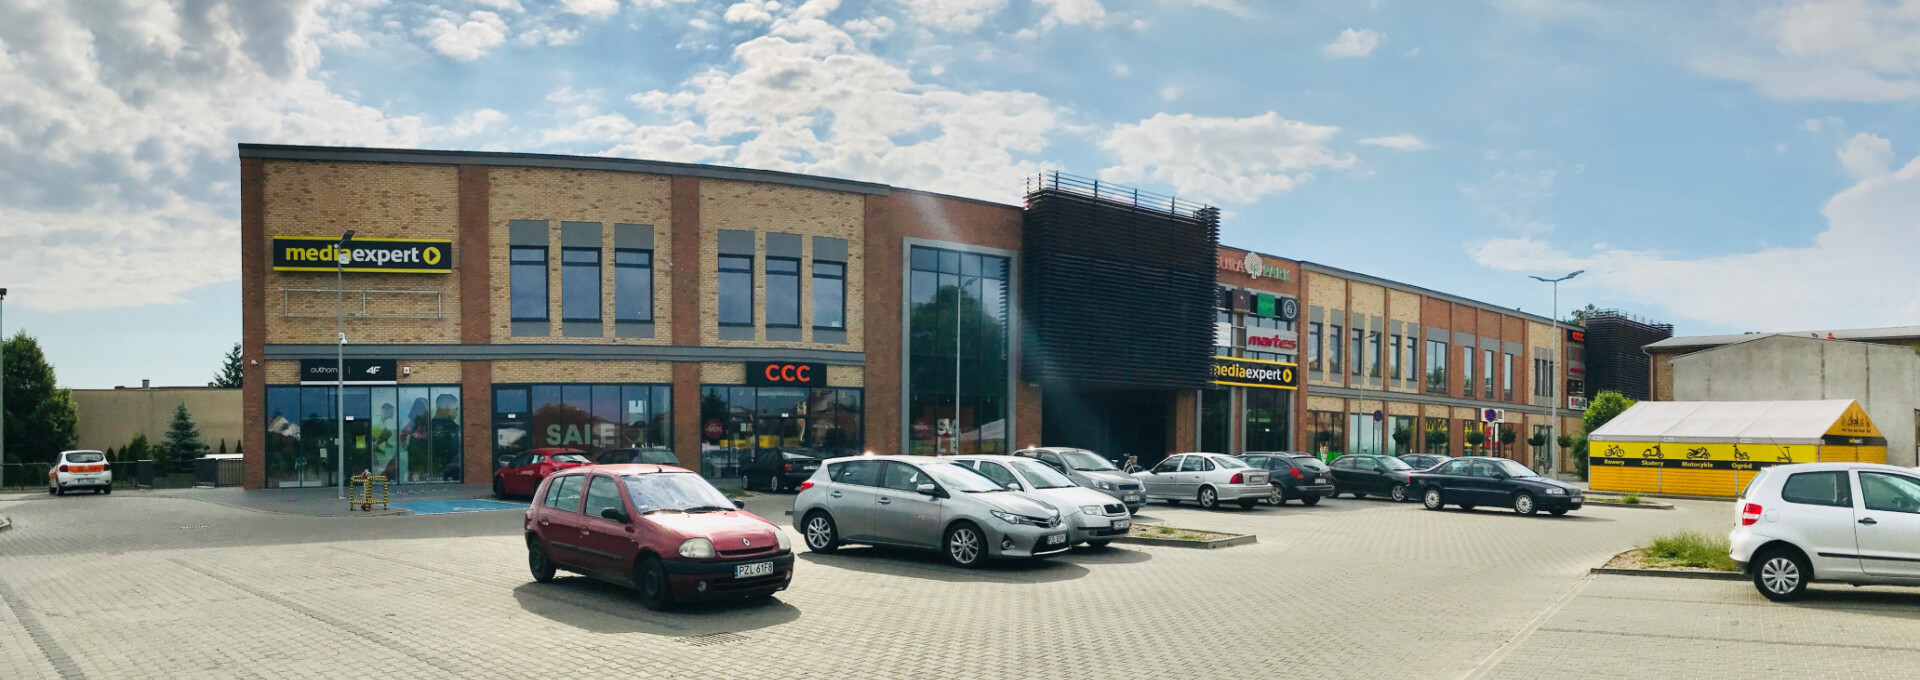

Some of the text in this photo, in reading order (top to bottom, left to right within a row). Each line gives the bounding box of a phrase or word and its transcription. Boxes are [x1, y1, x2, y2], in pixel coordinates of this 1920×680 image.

[285, 243, 420, 266] mediaexpert
[1263, 265, 1290, 280] PARK
[1248, 334, 1297, 350] martes
[366, 366, 382, 375] 4F
[764, 364, 811, 382] CCC
[546, 423, 616, 446] SALE
[1681, 461, 1714, 469] Motocykle
[1731, 462, 1753, 470] Ogród
[738, 565, 755, 576] PZL
